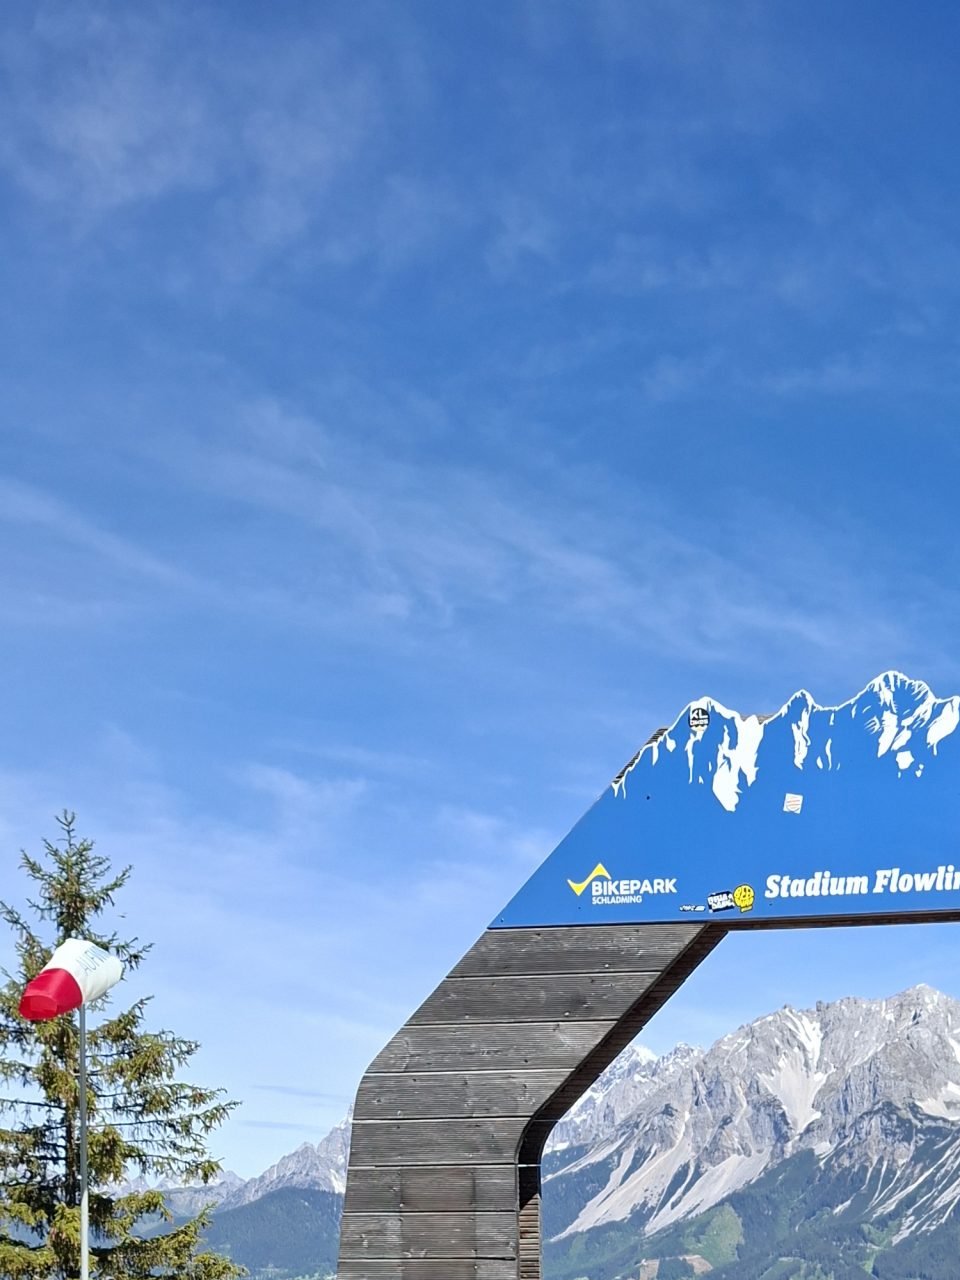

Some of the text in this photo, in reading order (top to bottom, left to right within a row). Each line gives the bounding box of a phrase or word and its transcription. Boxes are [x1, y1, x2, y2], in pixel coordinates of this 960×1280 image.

[591, 878, 677, 896] BIKEPARK
[764, 871, 868, 898] Stadium
[592, 895, 642, 905] SCHLADMING
